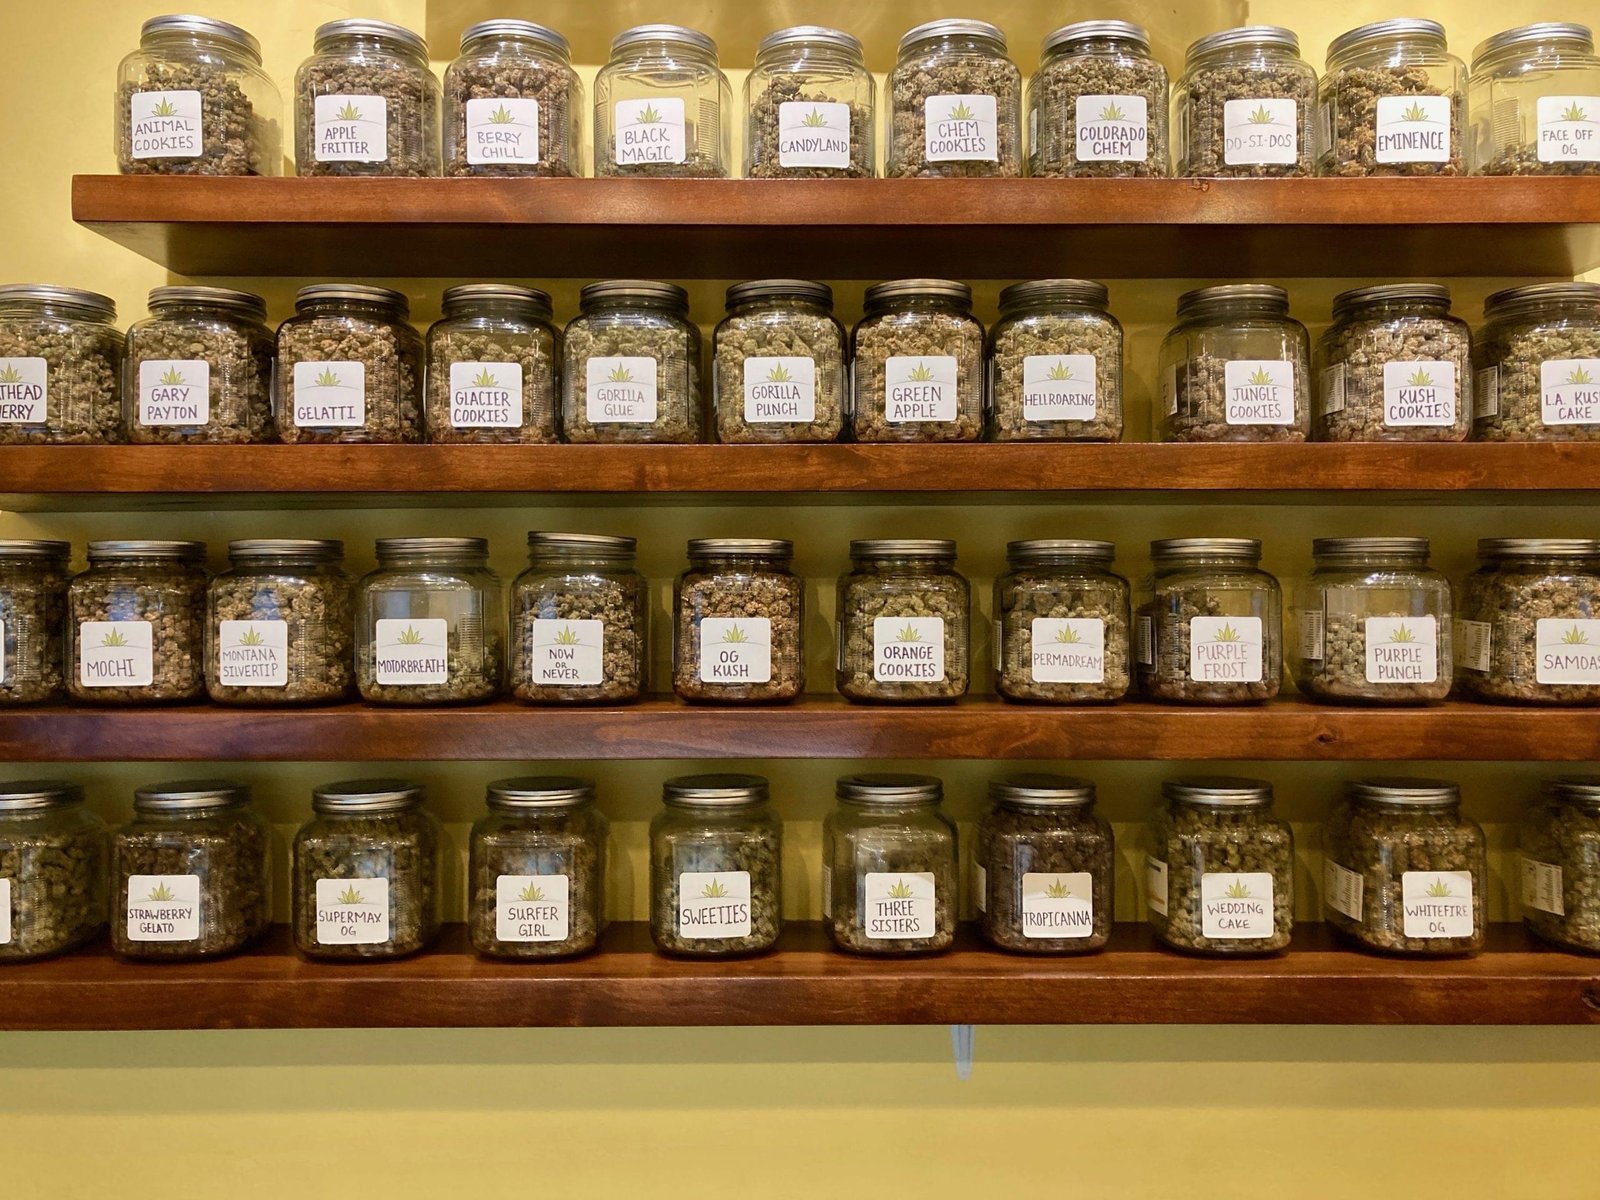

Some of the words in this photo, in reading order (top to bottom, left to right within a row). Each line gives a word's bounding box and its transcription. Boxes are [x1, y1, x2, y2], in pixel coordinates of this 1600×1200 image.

[135, 119, 194, 136] ANIMAL
[324, 126, 357, 140] APPLE
[938, 122, 979, 138] CHEM
[1079, 127, 1145, 142] COLORADO
[477, 131, 522, 145] BERRY
[624, 128, 671, 144] BLACK
[1378, 131, 1444, 152] EMINENCE
[1542, 129, 1569, 142] FACE
[1575, 129, 1593, 140] OFF
[135, 136, 194, 151] COOKIES
[321, 142, 369, 155] FRITTER
[930, 138, 986, 154] COOKIES
[1092, 141, 1132, 156] CHEM
[1562, 143, 1578, 156] OG
[482, 145, 524, 159] CHILL
[622, 146, 674, 162] MAGIC
[0, 384, 43, 402] THEAD
[151, 387, 190, 403] GARY
[455, 392, 511, 407] GLACIER
[597, 388, 645, 403] GORILLA
[752, 384, 801, 400] GORILLA
[892, 385, 942, 402] GREEN
[1233, 387, 1278, 402] JUNGLE
[1399, 388, 1436, 403] KUSH
[1545, 392, 1567, 407] L.A.
[1574, 390, 1600, 406] KUS
[1024, 393, 1095, 407] HELLROARING
[0, 403, 34, 420] ERRY
[147, 404, 198, 420] PAYTON
[297, 405, 356, 420] GELATTI
[454, 408, 508, 423] COOKIES
[604, 403, 635, 416] GLUE
[756, 401, 798, 416] PUNCH
[894, 403, 937, 418] APPLE
[1230, 403, 1282, 419] COOKIES
[1389, 403, 1451, 419] COOKIES
[1558, 405, 1592, 420] CAKE
[223, 648, 276, 661] MONTANA
[549, 647, 574, 660] NOW
[719, 651, 739, 663] OG
[883, 646, 933, 660] ORANGE
[1197, 644, 1248, 661] PURPLE
[1375, 648, 1422, 663] PURPLE
[87, 659, 136, 677] MOCHI
[223, 663, 279, 678] SILVERTIP
[378, 658, 445, 674] MOTORBREATH
[543, 668, 580, 679] NEVER
[713, 664, 749, 677] KUSH
[879, 663, 936, 677] COOKIES
[1204, 662, 1247, 678] FROST
[1378, 664, 1422, 680] PUNCH
[128, 908, 192, 920] STRAWBERRY
[508, 907, 559, 922] SURFER
[681, 904, 748, 926] SWEETIES
[876, 900, 914, 917] THREE
[1207, 902, 1264, 916] WEDDING
[1405, 904, 1468, 918] WHITEFIRE
[319, 910, 382, 925] SUPERMAX
[871, 917, 920, 933] SISTERS
[1023, 910, 1091, 927] TROPICANNA
[1218, 917, 1251, 929] CAKE
[139, 921, 175, 934] GELATO
[341, 925, 356, 936] OG
[518, 924, 550, 937] GIRL
[1429, 920, 1445, 933] OG
